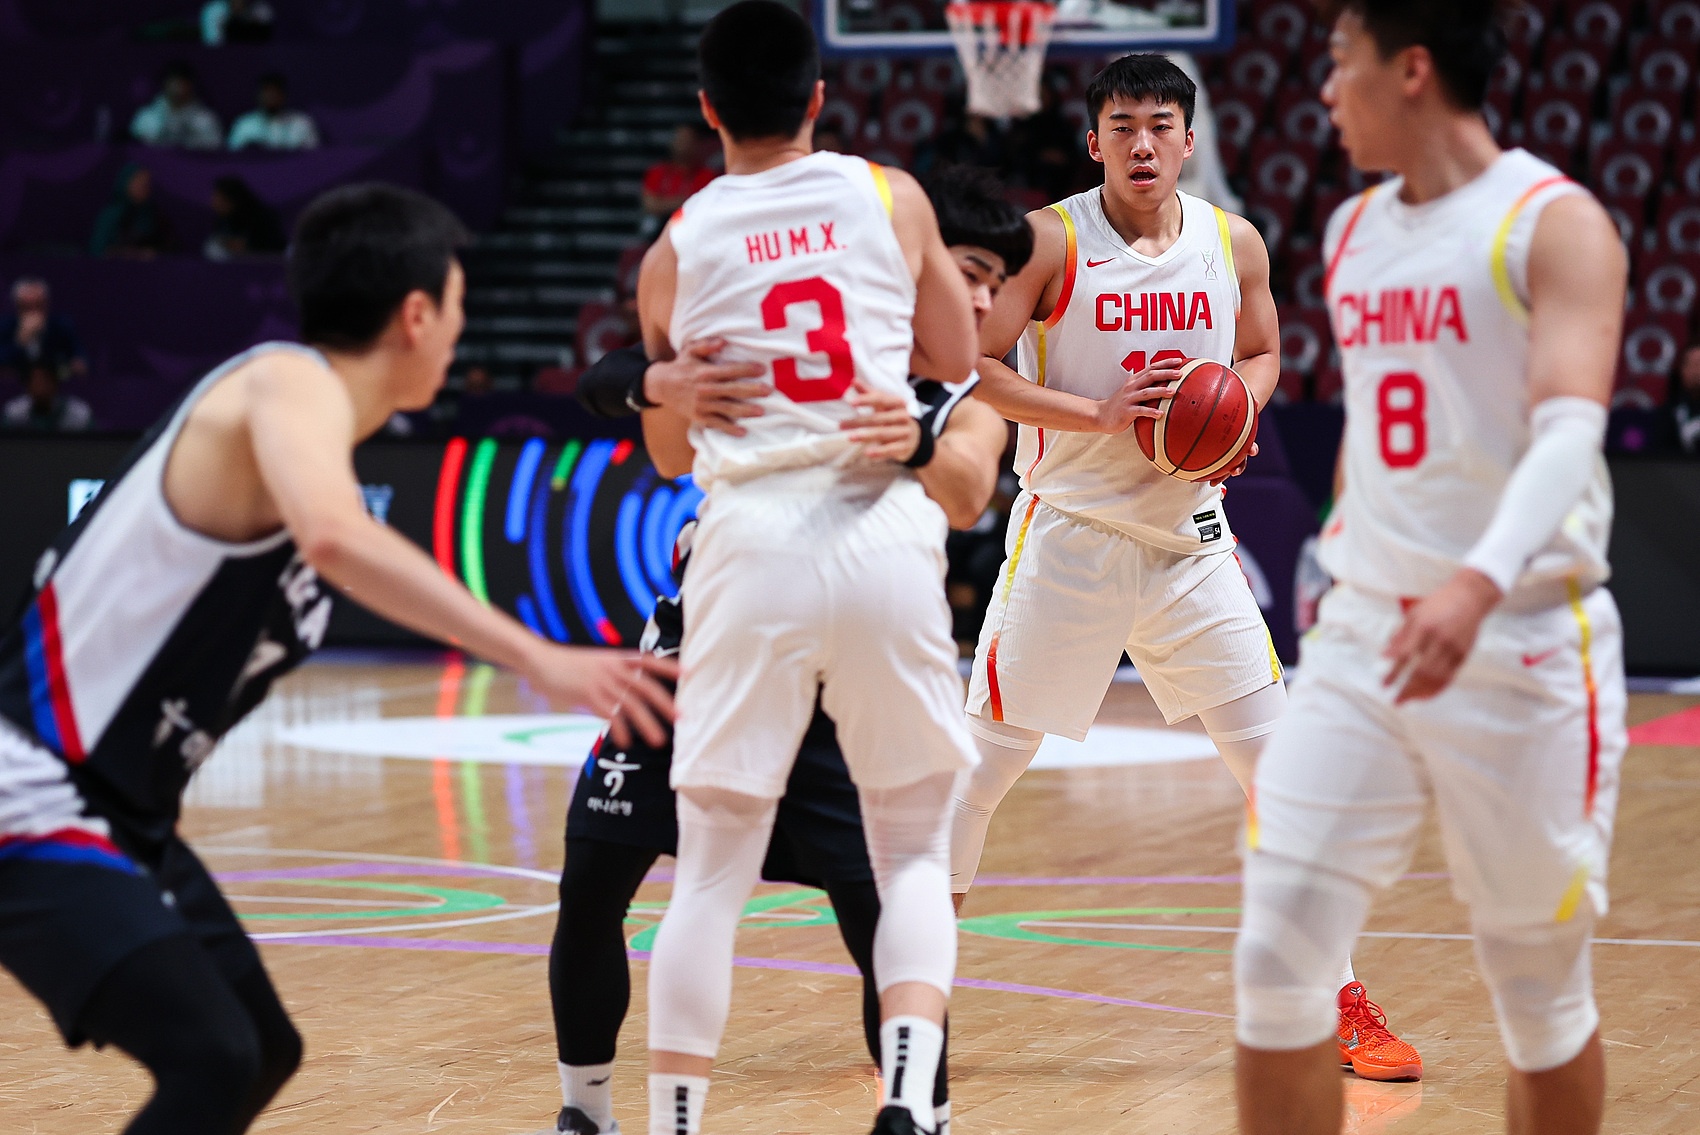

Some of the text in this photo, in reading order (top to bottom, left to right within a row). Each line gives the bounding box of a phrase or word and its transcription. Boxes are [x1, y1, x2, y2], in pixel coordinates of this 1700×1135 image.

[746, 231, 781, 264] HU
[760, 275, 856, 404] 3
[1095, 291, 1213, 331] CHINA
[1337, 285, 1469, 347] CHINA
[1377, 371, 1428, 471] 8
